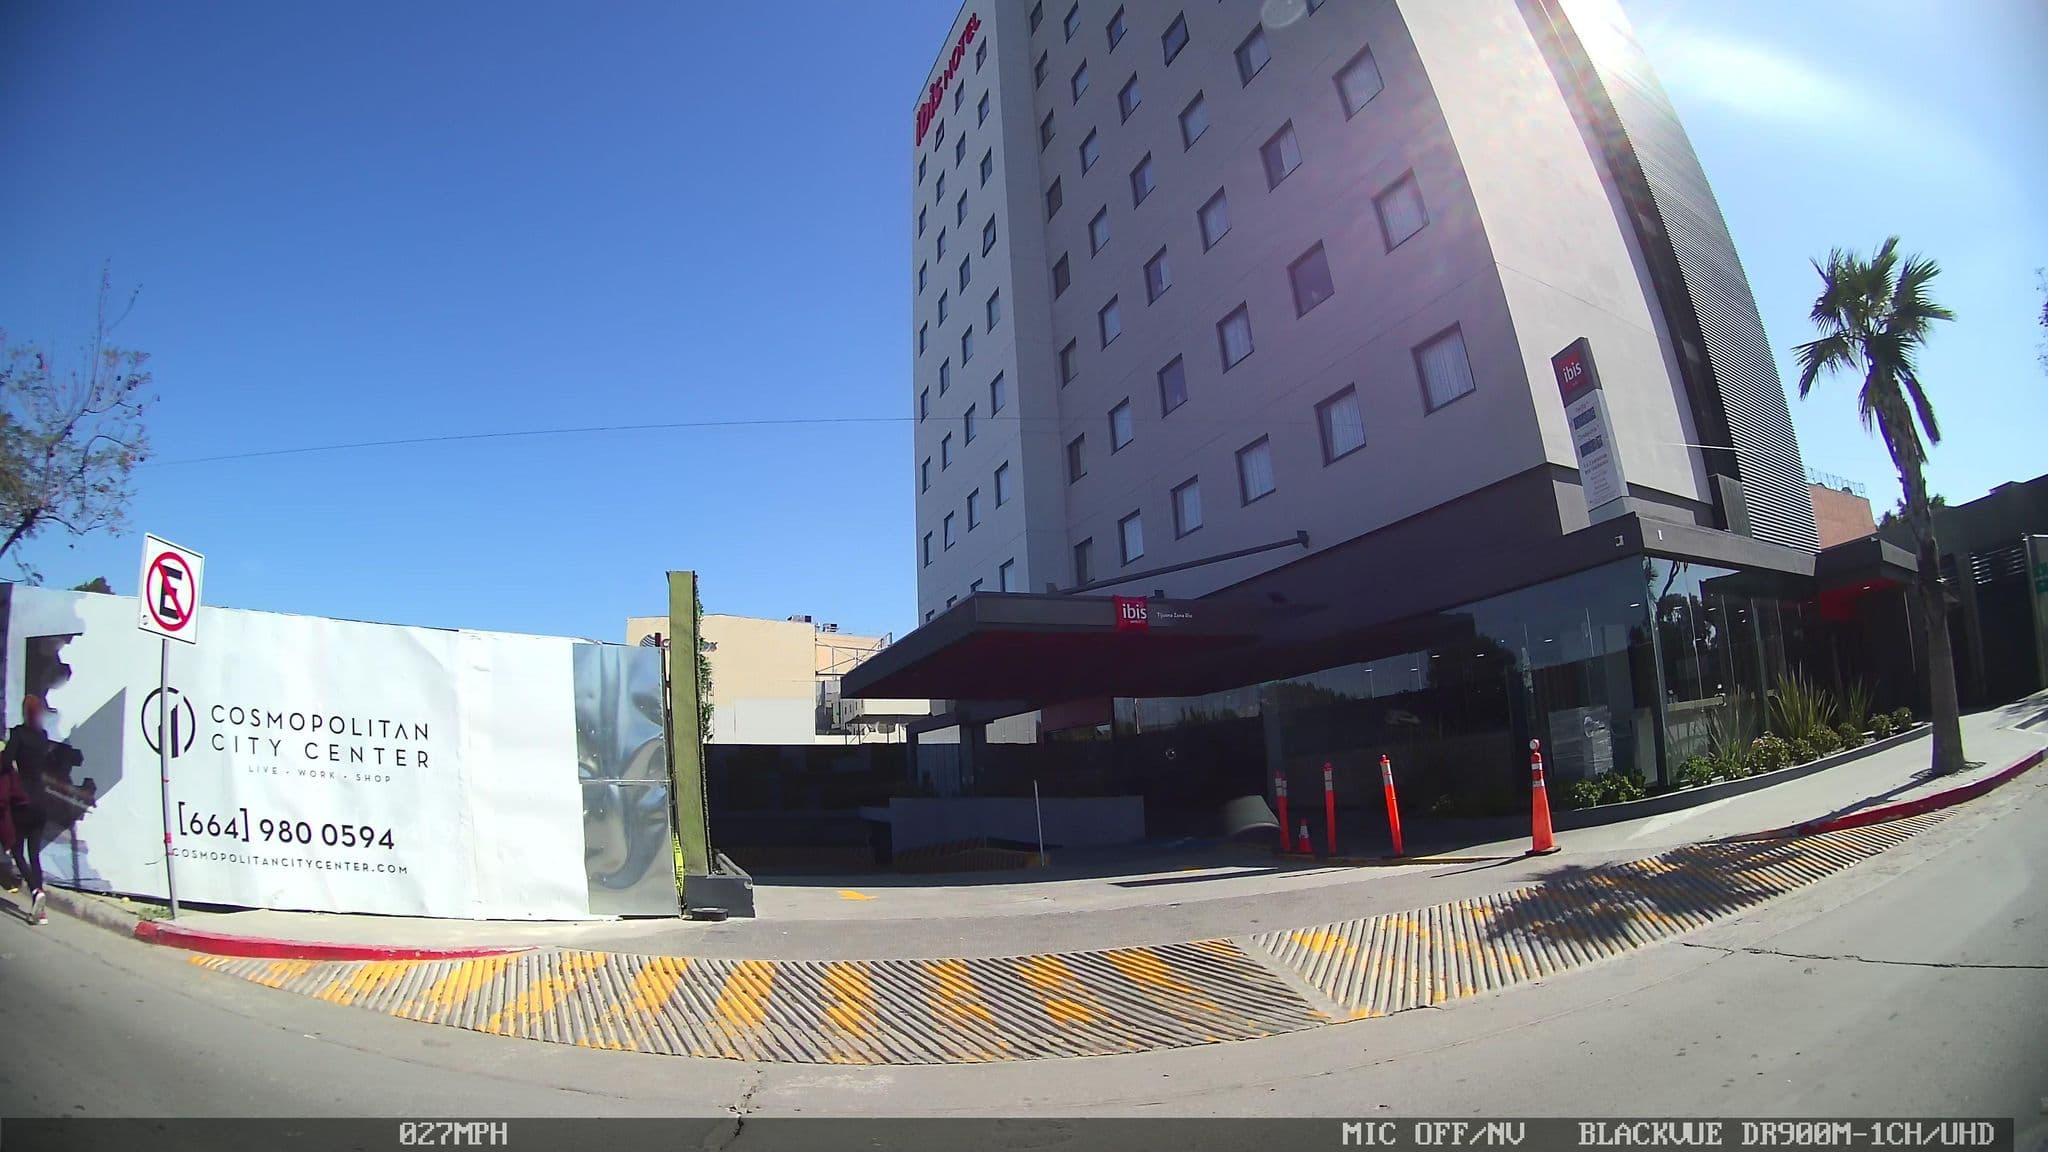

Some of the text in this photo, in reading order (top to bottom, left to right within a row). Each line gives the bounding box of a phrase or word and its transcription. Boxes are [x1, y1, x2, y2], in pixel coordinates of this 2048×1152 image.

[1562, 361, 1582, 383] ibis
[159, 564, 183, 620] E
[1122, 603, 1147, 619] ibis
[211, 704, 429, 741] COSMOPOLITAN
[211, 733, 429, 769] CITY CENTER
[248, 765, 391, 783] LIVE WORK SHOP
[178, 801, 395, 850] [664] 980 0594
[172, 847, 408, 875] COSMOPOLITANCITYCENTER.COM
